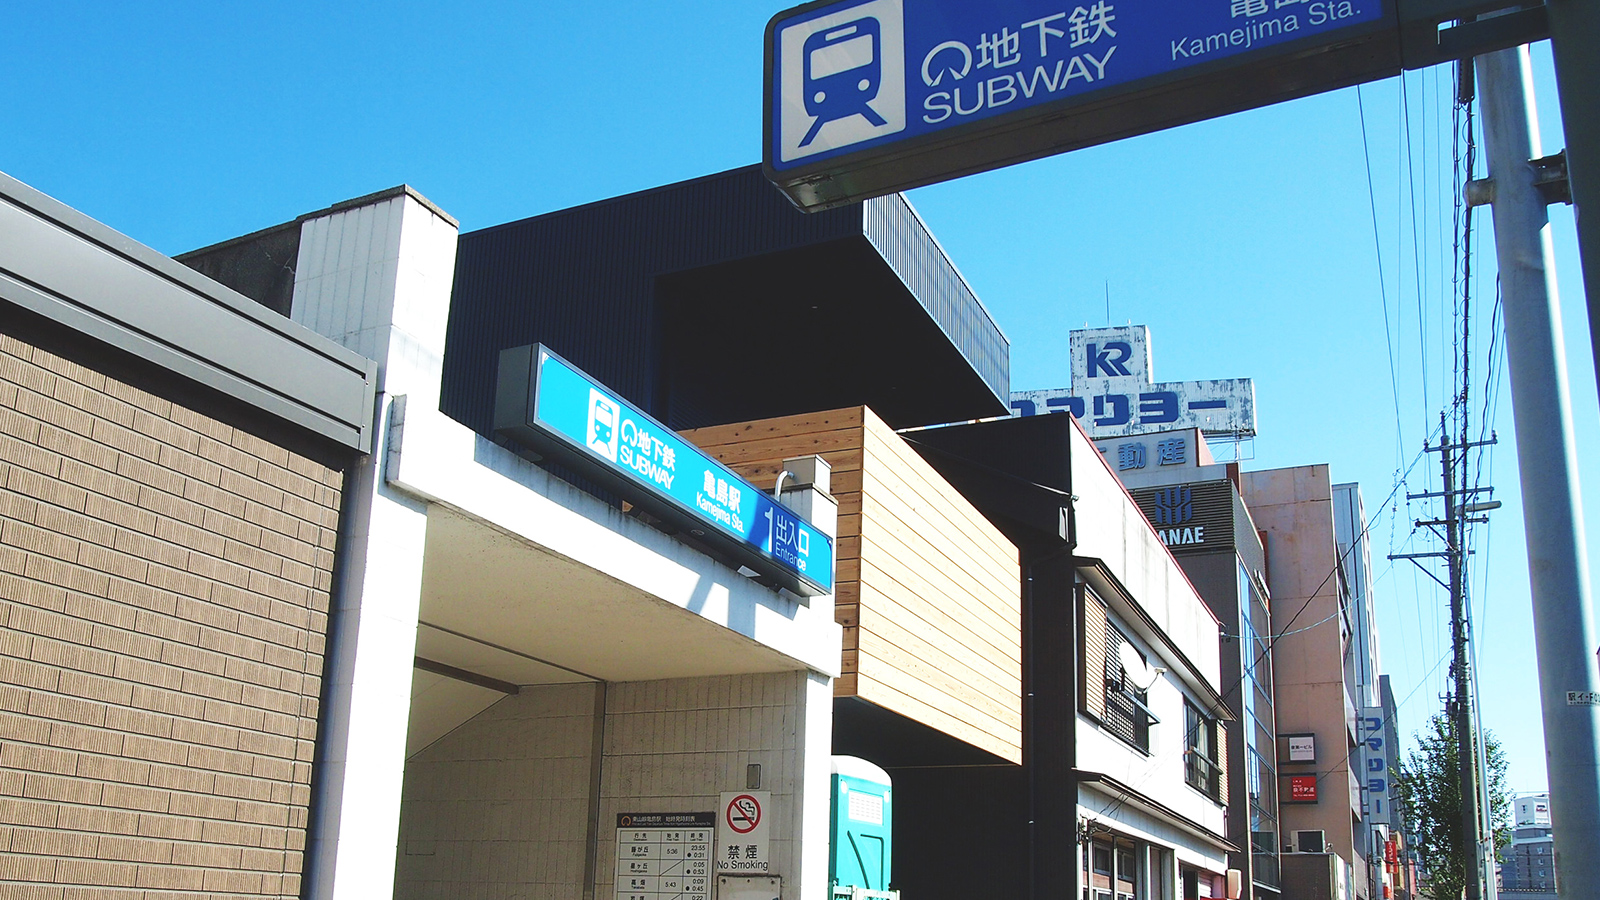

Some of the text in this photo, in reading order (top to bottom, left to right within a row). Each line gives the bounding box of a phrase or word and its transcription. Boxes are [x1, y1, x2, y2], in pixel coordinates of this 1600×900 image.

[976, 2, 1117, 71] 地下鉄
[1171, 15, 1299, 61] Kamejima
[1308, 0, 1361, 25] Sta.
[921, 45, 1117, 124] SUBWAY
[1086, 341, 1132, 378] KR
[620, 445, 675, 490] SUBWAY
[636, 427, 676, 473] 地下鉄
[1098, 438, 1186, 472] 動産
[696, 491, 745, 533] Kamejima Sta.
[703, 469, 742, 514] 亀島駅
[764, 506, 810, 558] 1 出入口
[1156, 526, 1205, 546] ANAE
[775, 542, 807, 571] Entrance
[717, 860, 768, 872] No Smoking
[727, 844, 757, 860] 禁煙
